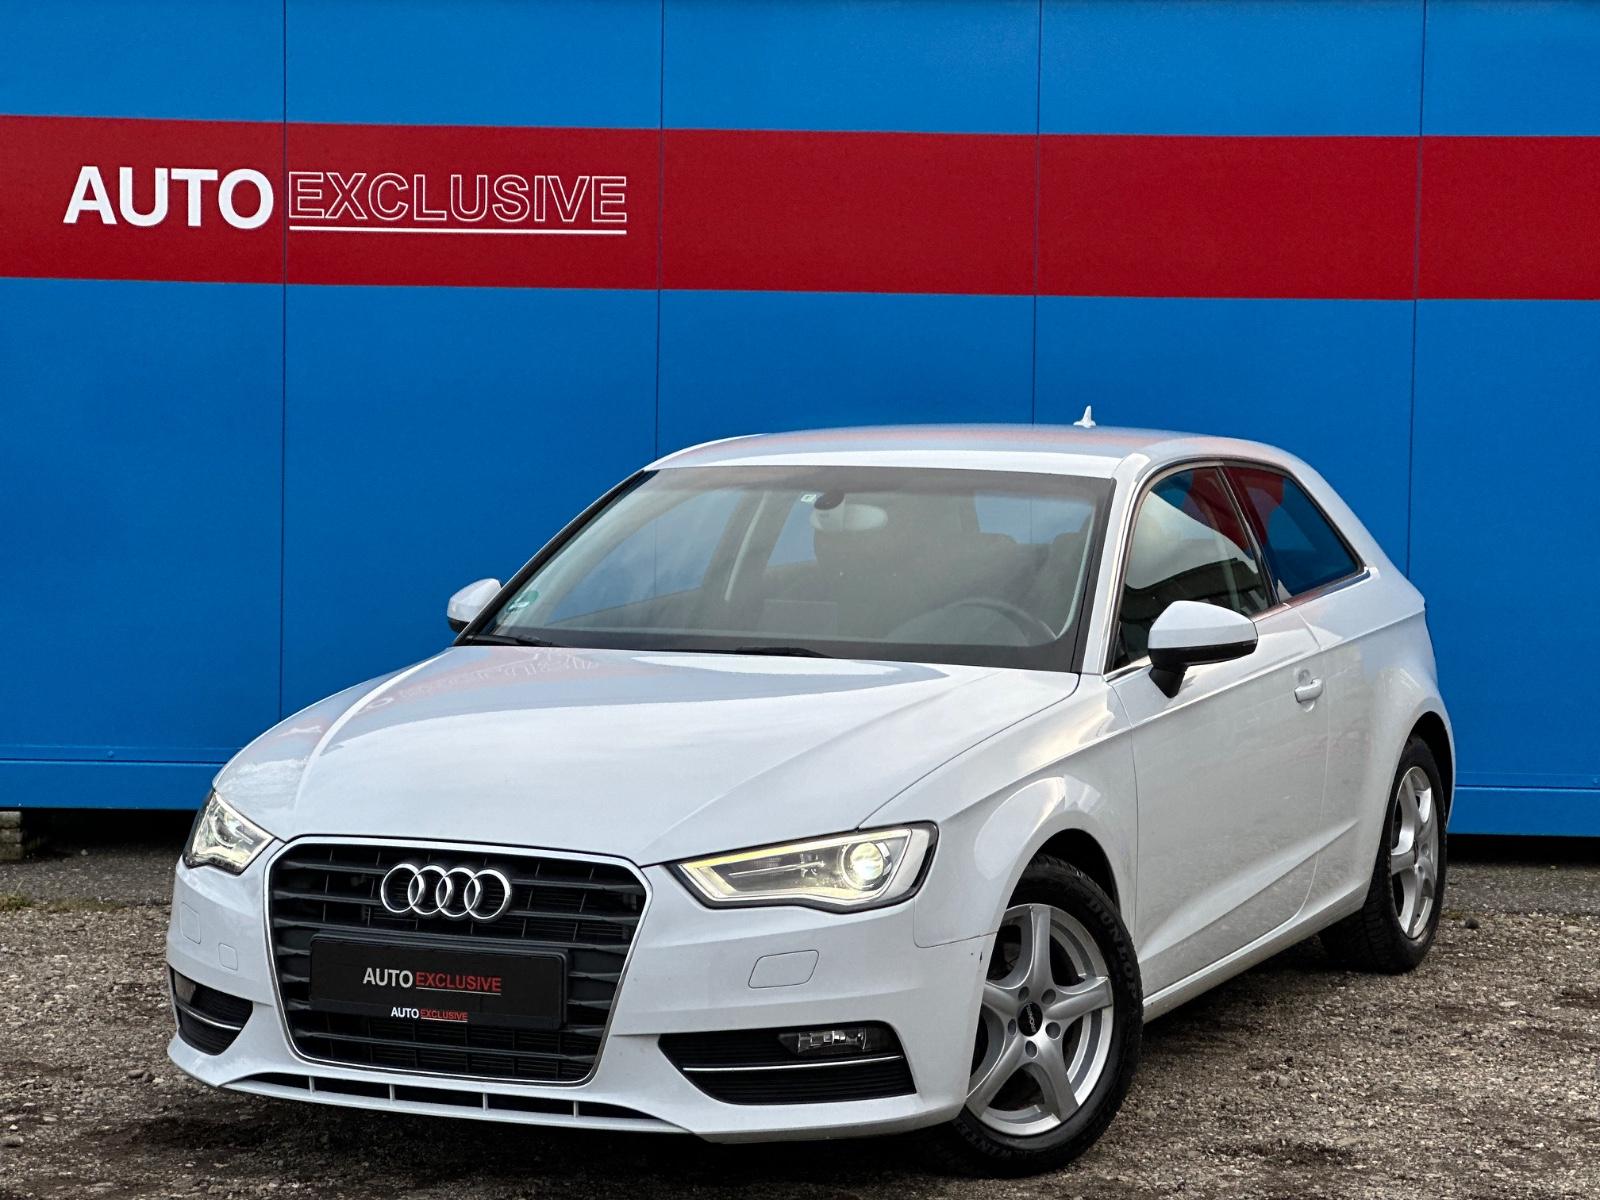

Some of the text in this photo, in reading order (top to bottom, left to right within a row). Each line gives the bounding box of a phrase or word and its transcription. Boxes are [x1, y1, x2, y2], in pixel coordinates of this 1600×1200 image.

[63, 165, 628, 230] AUTO EXCLUSIVE
[362, 967, 502, 993] AUTO EXCLUSIVE
[390, 1006, 468, 1021] AUTO EXCLUSIVE
